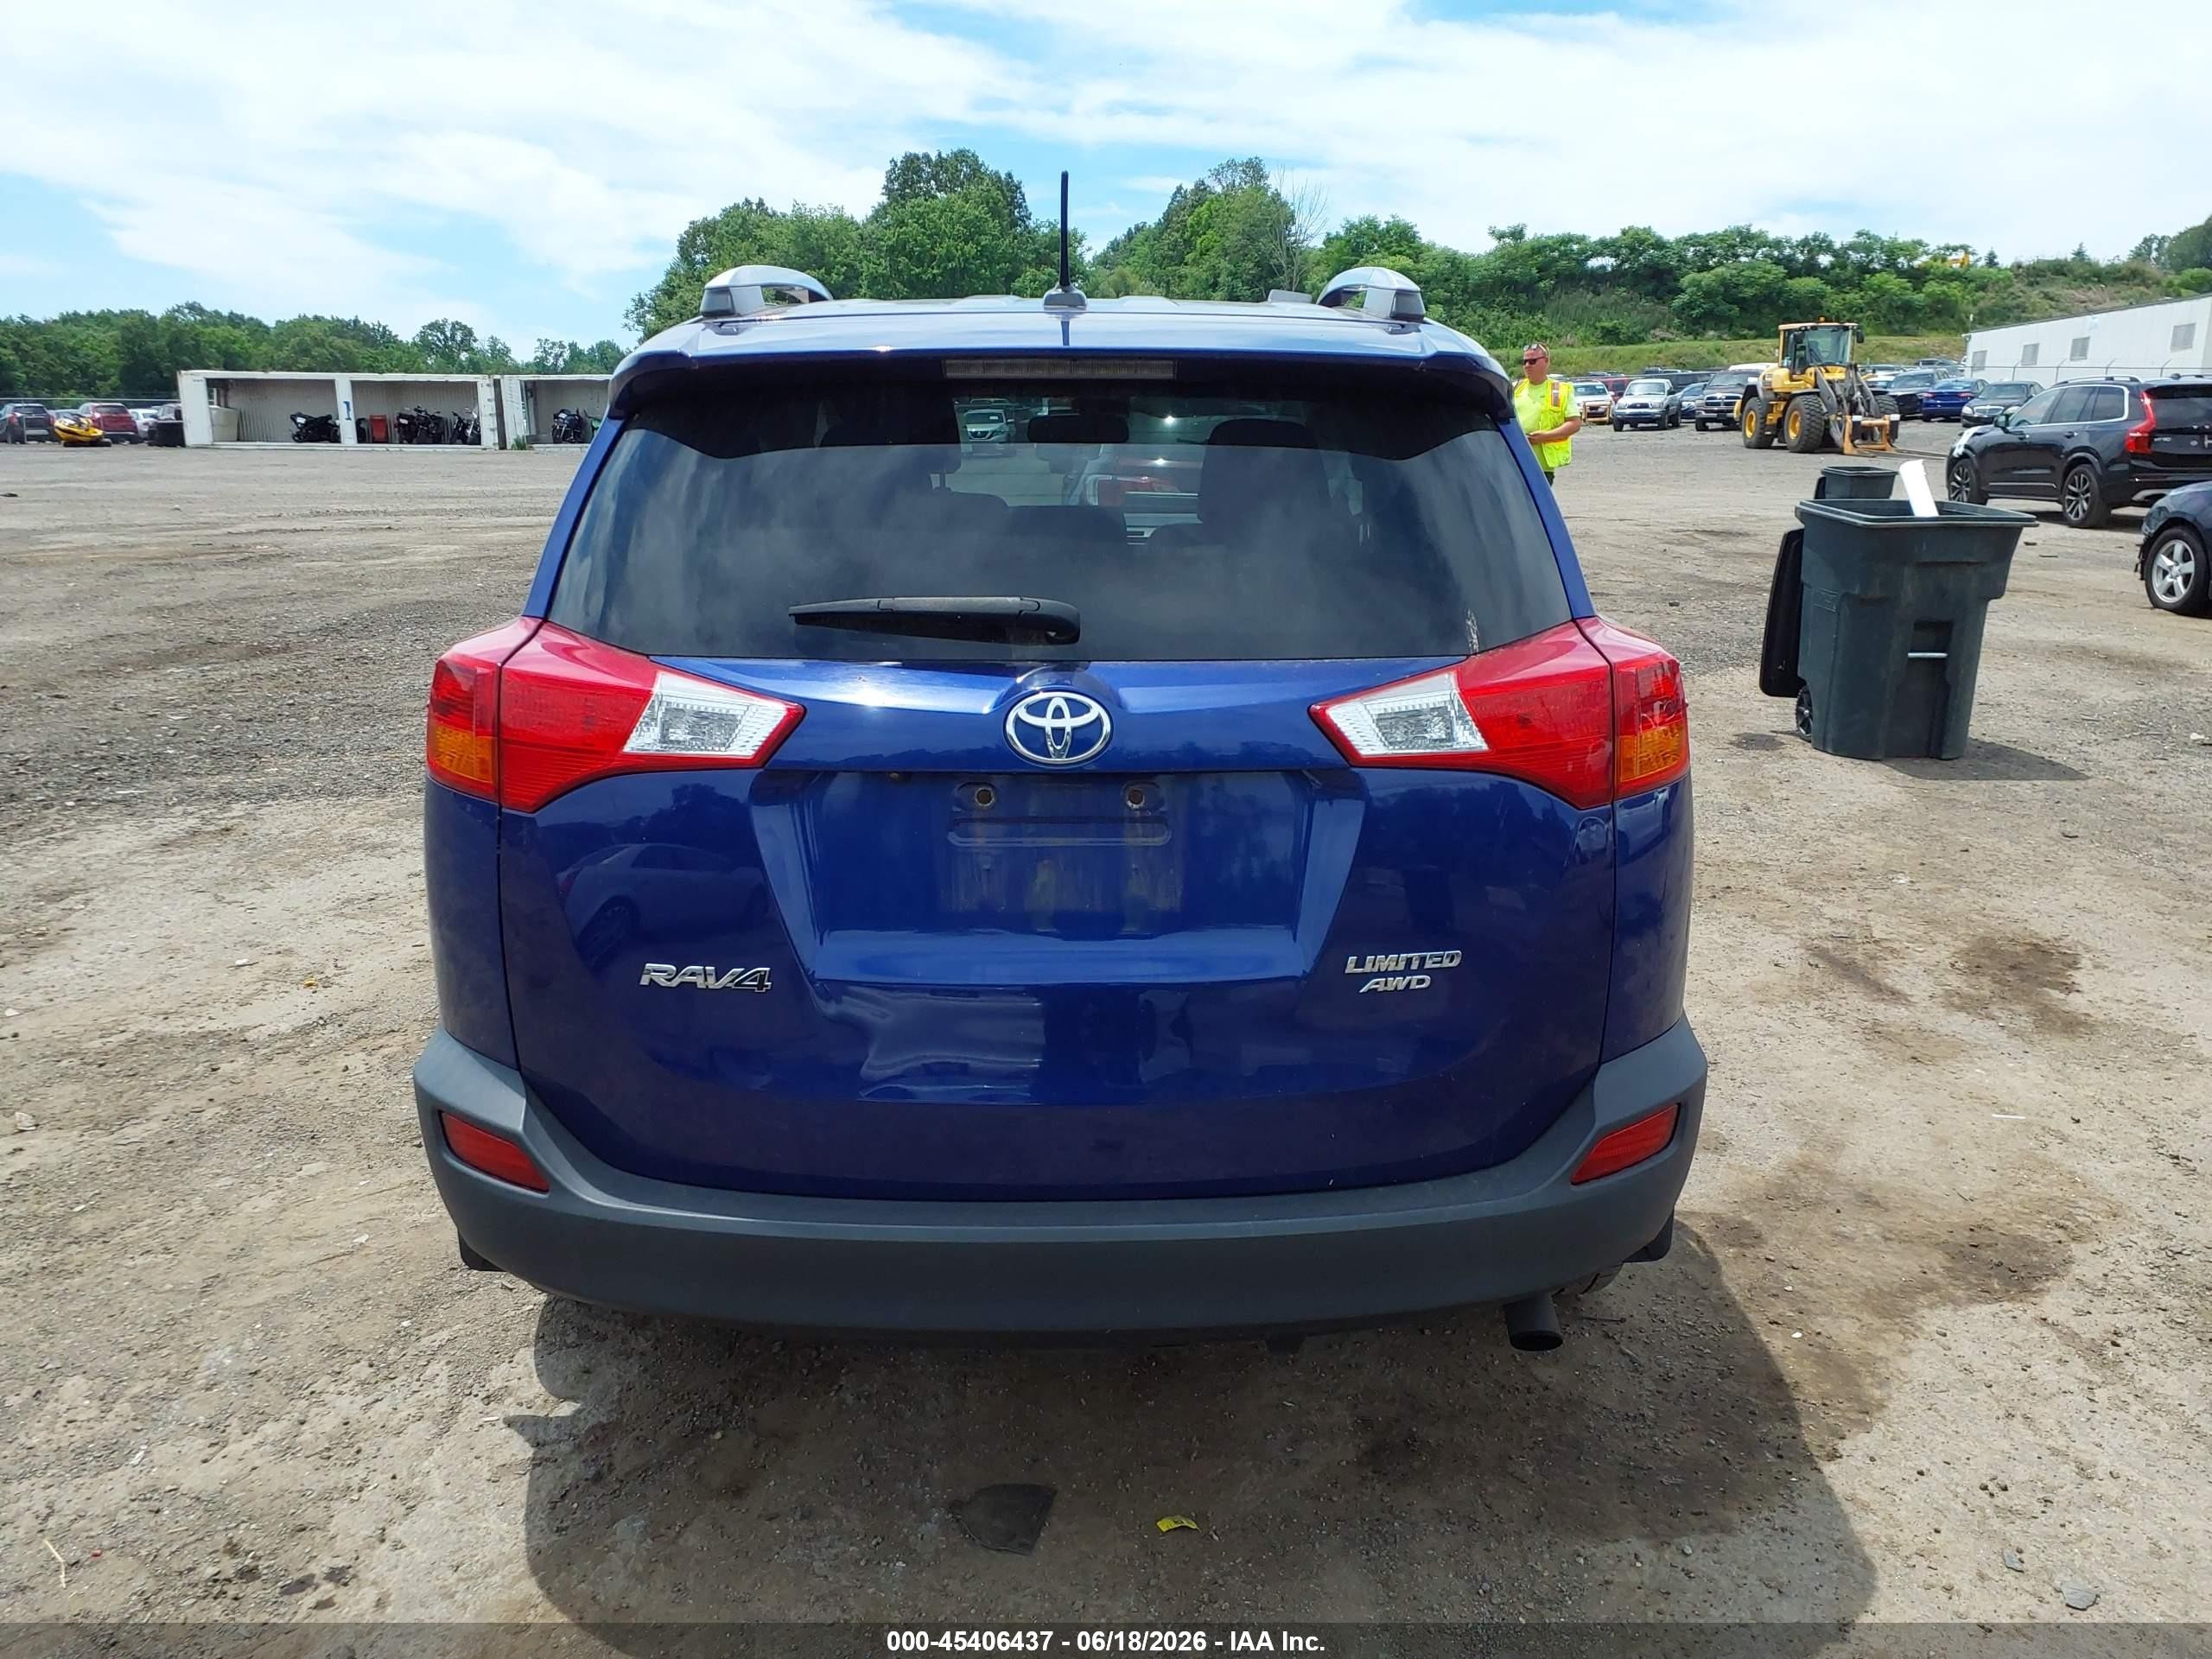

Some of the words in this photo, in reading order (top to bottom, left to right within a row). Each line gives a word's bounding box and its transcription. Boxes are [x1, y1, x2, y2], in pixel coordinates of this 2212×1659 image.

[1344, 950, 1462, 974] LIMITED
[639, 963, 772, 993] RAV4
[1359, 975, 1431, 994] AWD
